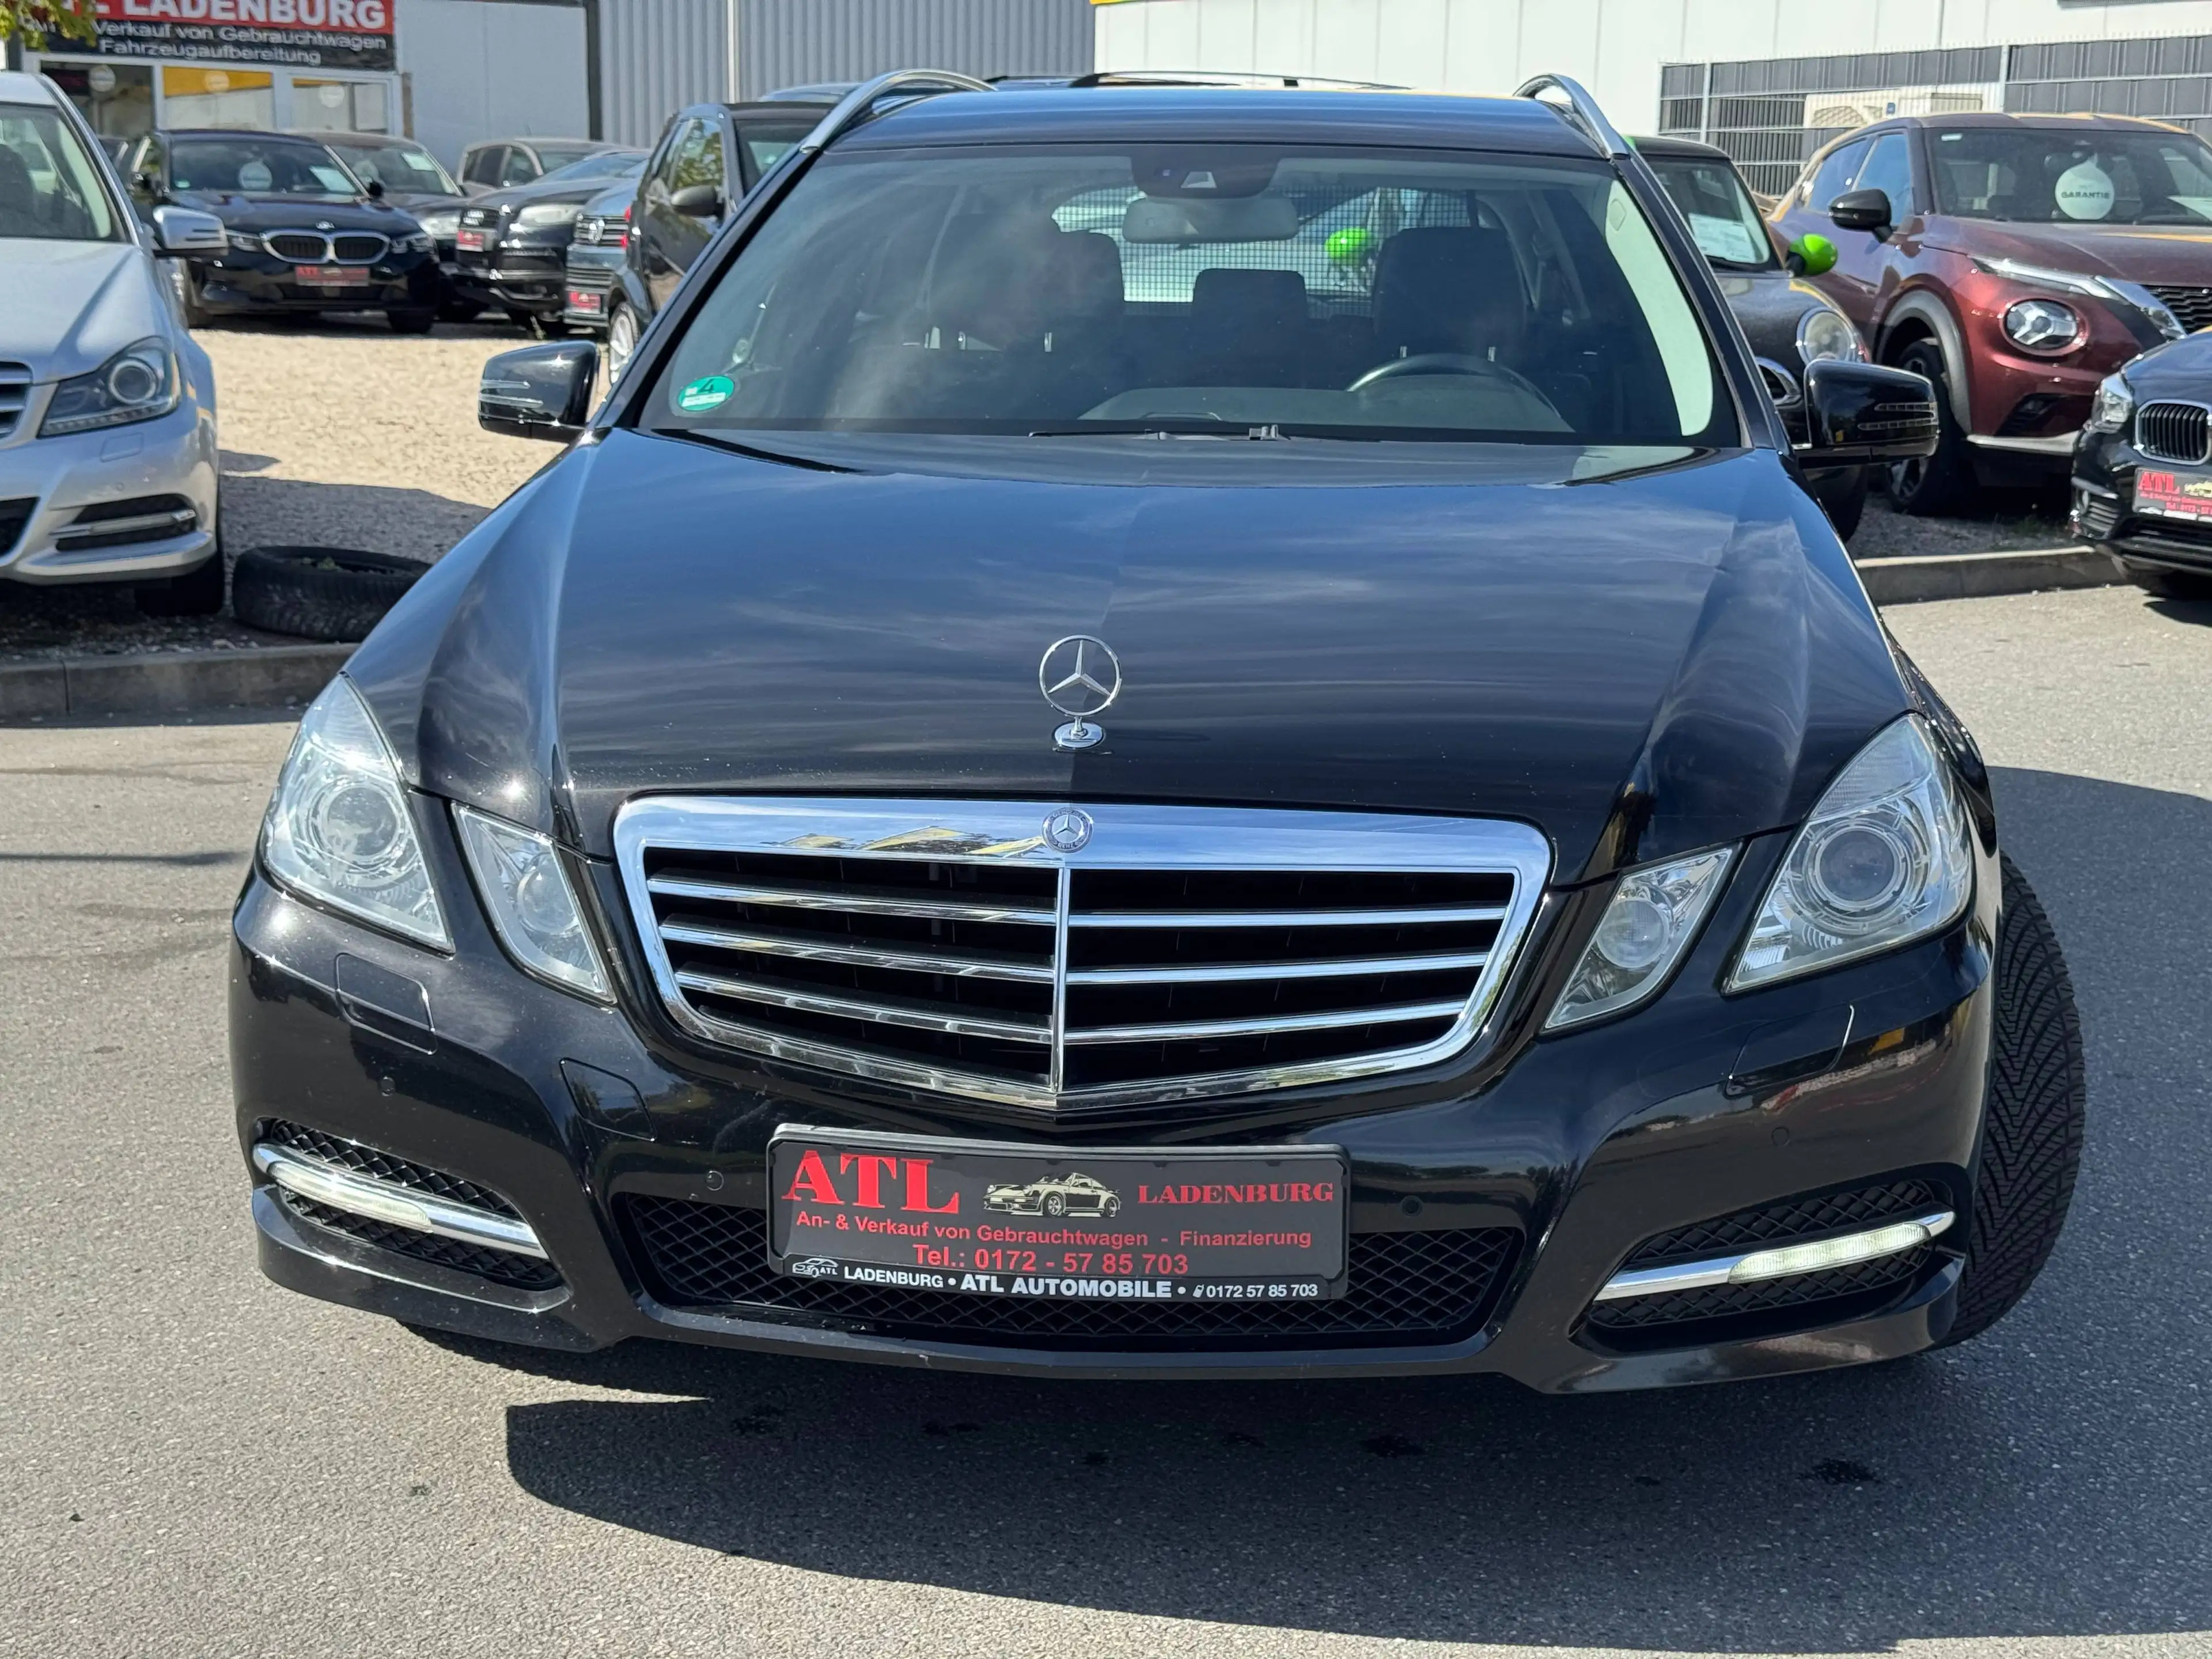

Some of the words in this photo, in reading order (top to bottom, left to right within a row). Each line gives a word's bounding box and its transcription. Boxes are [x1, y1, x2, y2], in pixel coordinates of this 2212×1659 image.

[123, 0, 387, 29] LADENBURG
[91, 18, 172, 37] Verkauf
[175, 26, 214, 41] von
[217, 26, 387, 52] Gebrauchtwagen
[99, 36, 321, 66] Fahrzeugaufbereitung
[697, 378, 715, 393] 4
[2138, 471, 2180, 494] ATL
[781, 1149, 960, 1214] ATL
[1138, 1182, 1334, 1204] LADENBURG
[796, 1211, 831, 1228] An-
[835, 1214, 850, 1230] &
[855, 1216, 930, 1238] Verkauf
[934, 1225, 971, 1239] von
[976, 1225, 1148, 1249] Gebrauchtwagen
[1180, 1229, 1312, 1248] Finanzierung
[912, 1244, 965, 1267] Tel.:
[975, 1248, 1037, 1272] 0172
[1063, 1252, 1094, 1273] 57
[1101, 1253, 1134, 1275] 85
[1142, 1253, 1188, 1275] 703
[844, 1266, 944, 1288] LADENBURG
[960, 1274, 1005, 1293] ATL
[1011, 1277, 1172, 1298] AUTOMOBILE
[1206, 1285, 1244, 1298] 0172
[1245, 1285, 1265, 1298] 57
[1268, 1284, 1287, 1297] 85
[1290, 1283, 1319, 1297] 703
